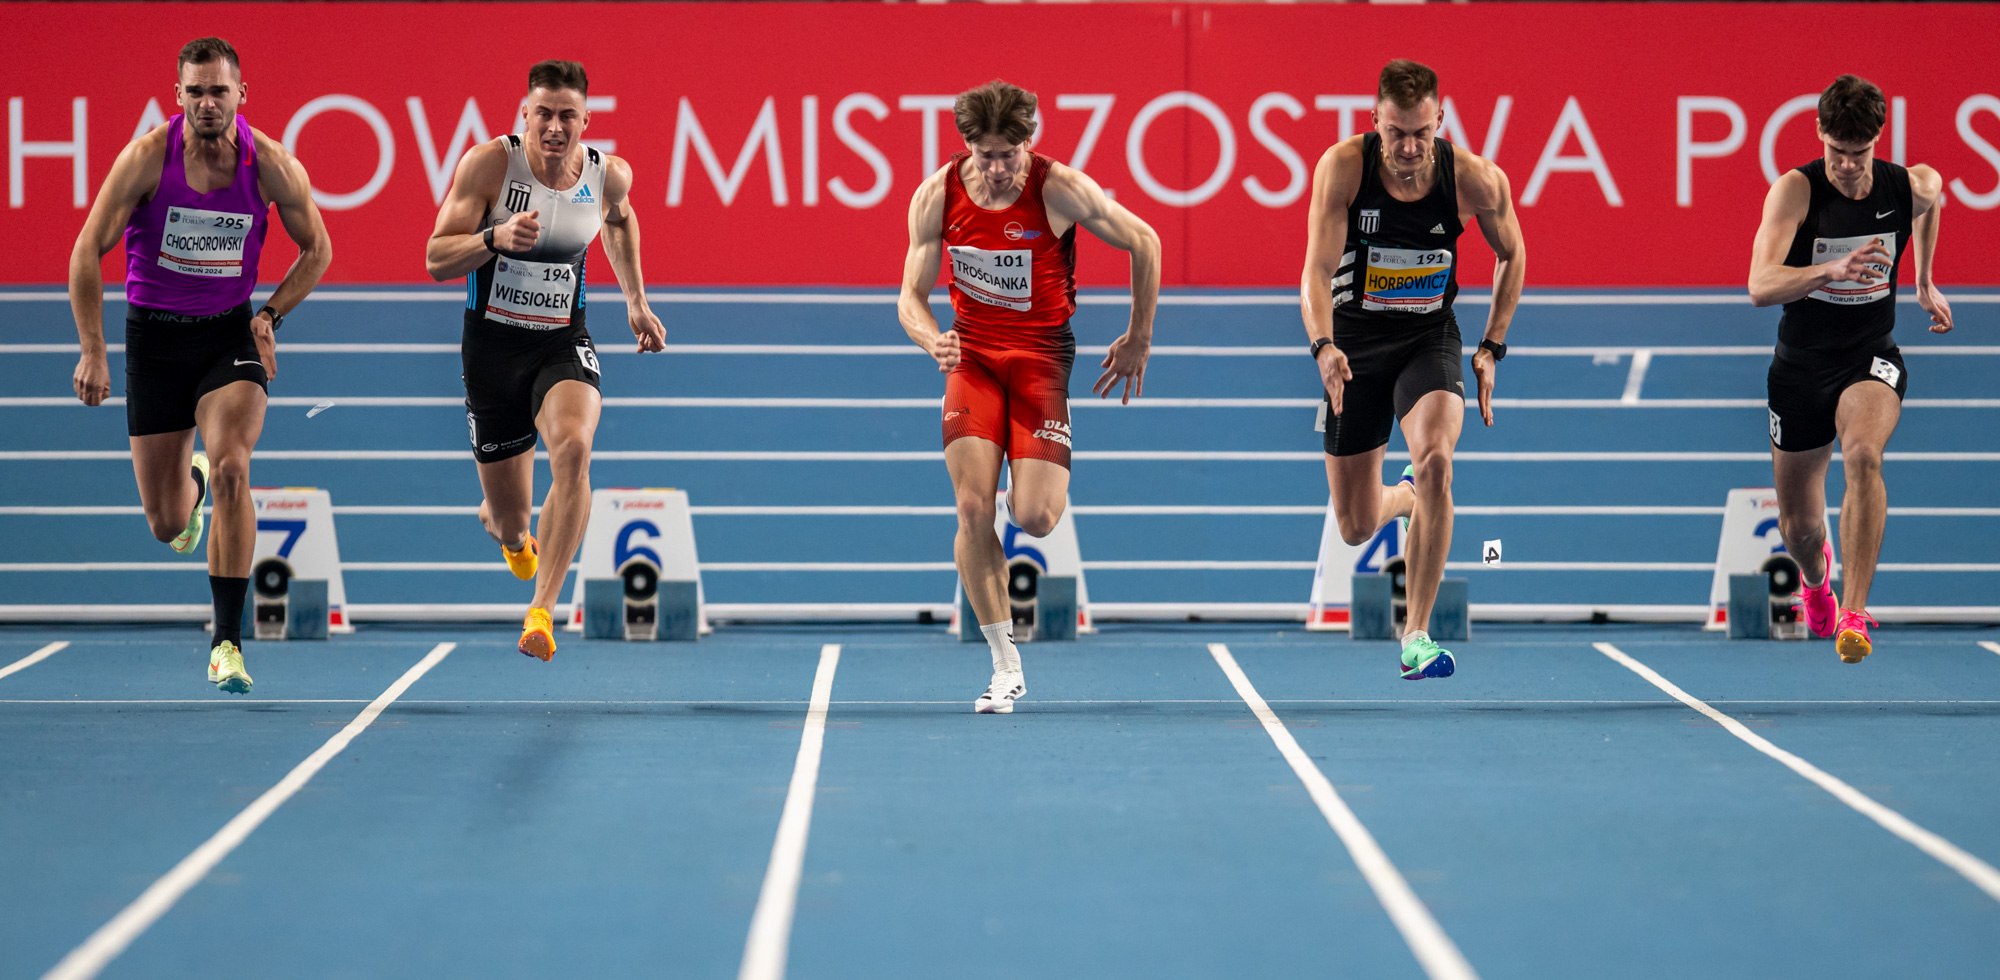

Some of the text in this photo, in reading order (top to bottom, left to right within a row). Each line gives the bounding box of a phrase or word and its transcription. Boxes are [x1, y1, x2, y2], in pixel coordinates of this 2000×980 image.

[572, 195, 595, 204] adidas
[213, 216, 245, 230] 295
[166, 233, 243, 252] CHOCHOROWSKI
[994, 254, 1024, 268] 101
[1416, 253, 1445, 265] 191
[178, 265, 204, 274] TORUŃ
[542, 268, 571, 282] 194
[955, 259, 1029, 290] TROŚCIANKA
[1368, 273, 1447, 291] HORBOWICZ
[495, 283, 570, 309] WIESIOŁEK
[970, 291, 1012, 308] TORUŃ 2024
[1828, 295, 1873, 303] TORUŃ 2024
[148, 311, 193, 323] NIKE
[505, 318, 531, 330] TORUŃ
[1772, 414, 1778, 438] 3
[257, 519, 307, 559] 7
[614, 519, 663, 574] 6
[1355, 518, 1400, 573] 4
[1485, 546, 1500, 564] 4
